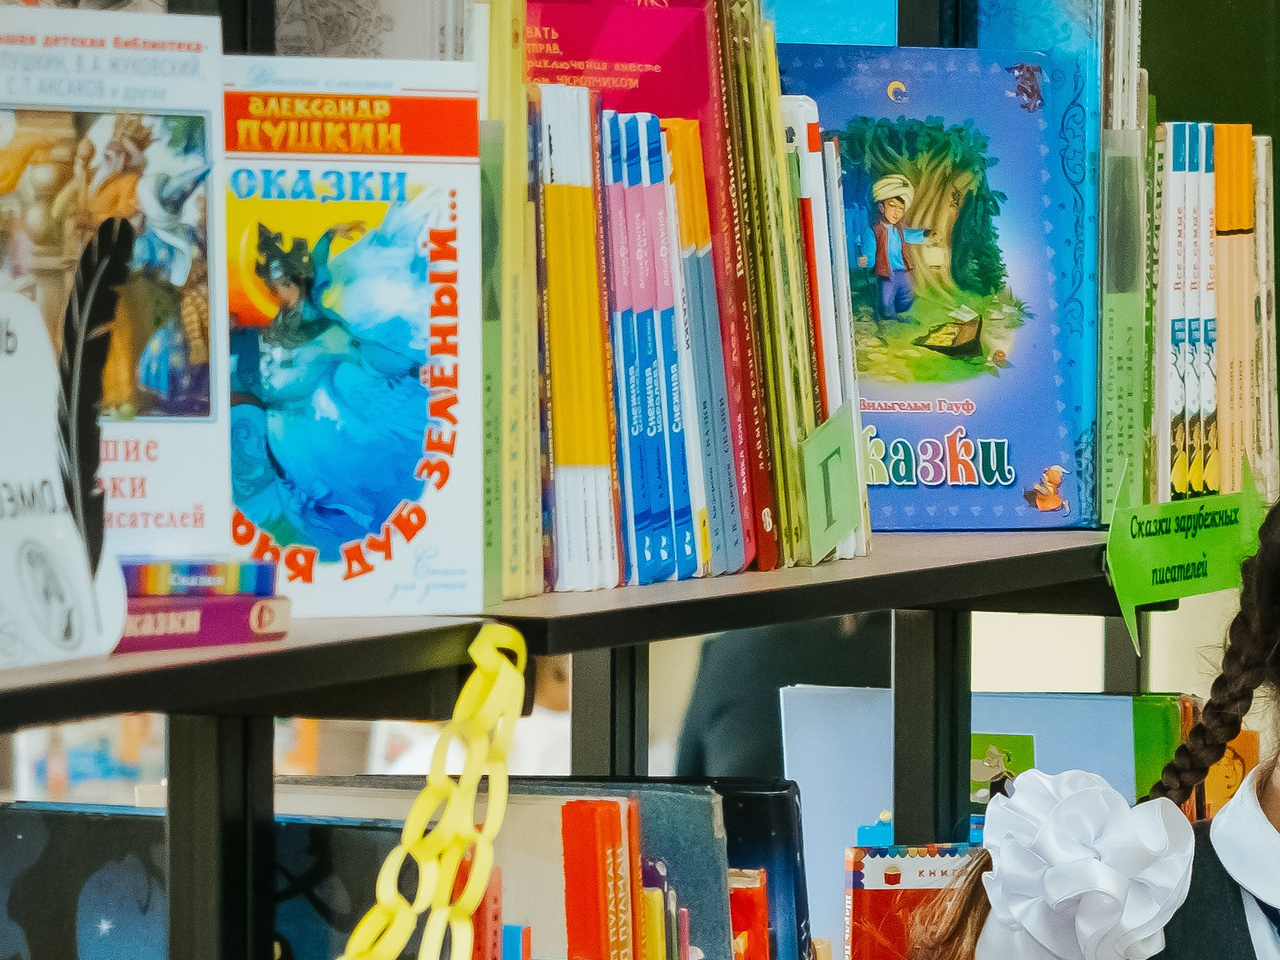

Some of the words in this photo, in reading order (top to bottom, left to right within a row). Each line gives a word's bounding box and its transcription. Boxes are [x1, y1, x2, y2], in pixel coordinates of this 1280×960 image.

[526, 60, 607, 71] риключения
[236, 118, 402, 152] ПУШКИН
[230, 168, 408, 204] СКАЗКИ
[628, 365, 640, 436] Снежная
[644, 367, 656, 437] Снежная
[859, 399, 931, 412] Вильгельм
[937, 399, 976, 414] Гауф
[100, 439, 159, 462] шие
[861, 425, 1016, 486] казки
[822, 446, 842, 532] Г
[103, 504, 206, 529] исателей
[1130, 515, 1172, 539] Сказки
[1174, 505, 1240, 540] зарубежных
[342, 501, 428, 582] ДУБ
[1151, 552, 1208, 586] писателей
[606, 848, 617, 943] ПУЛМАН
[616, 846, 628, 941] ПУЛМАН
